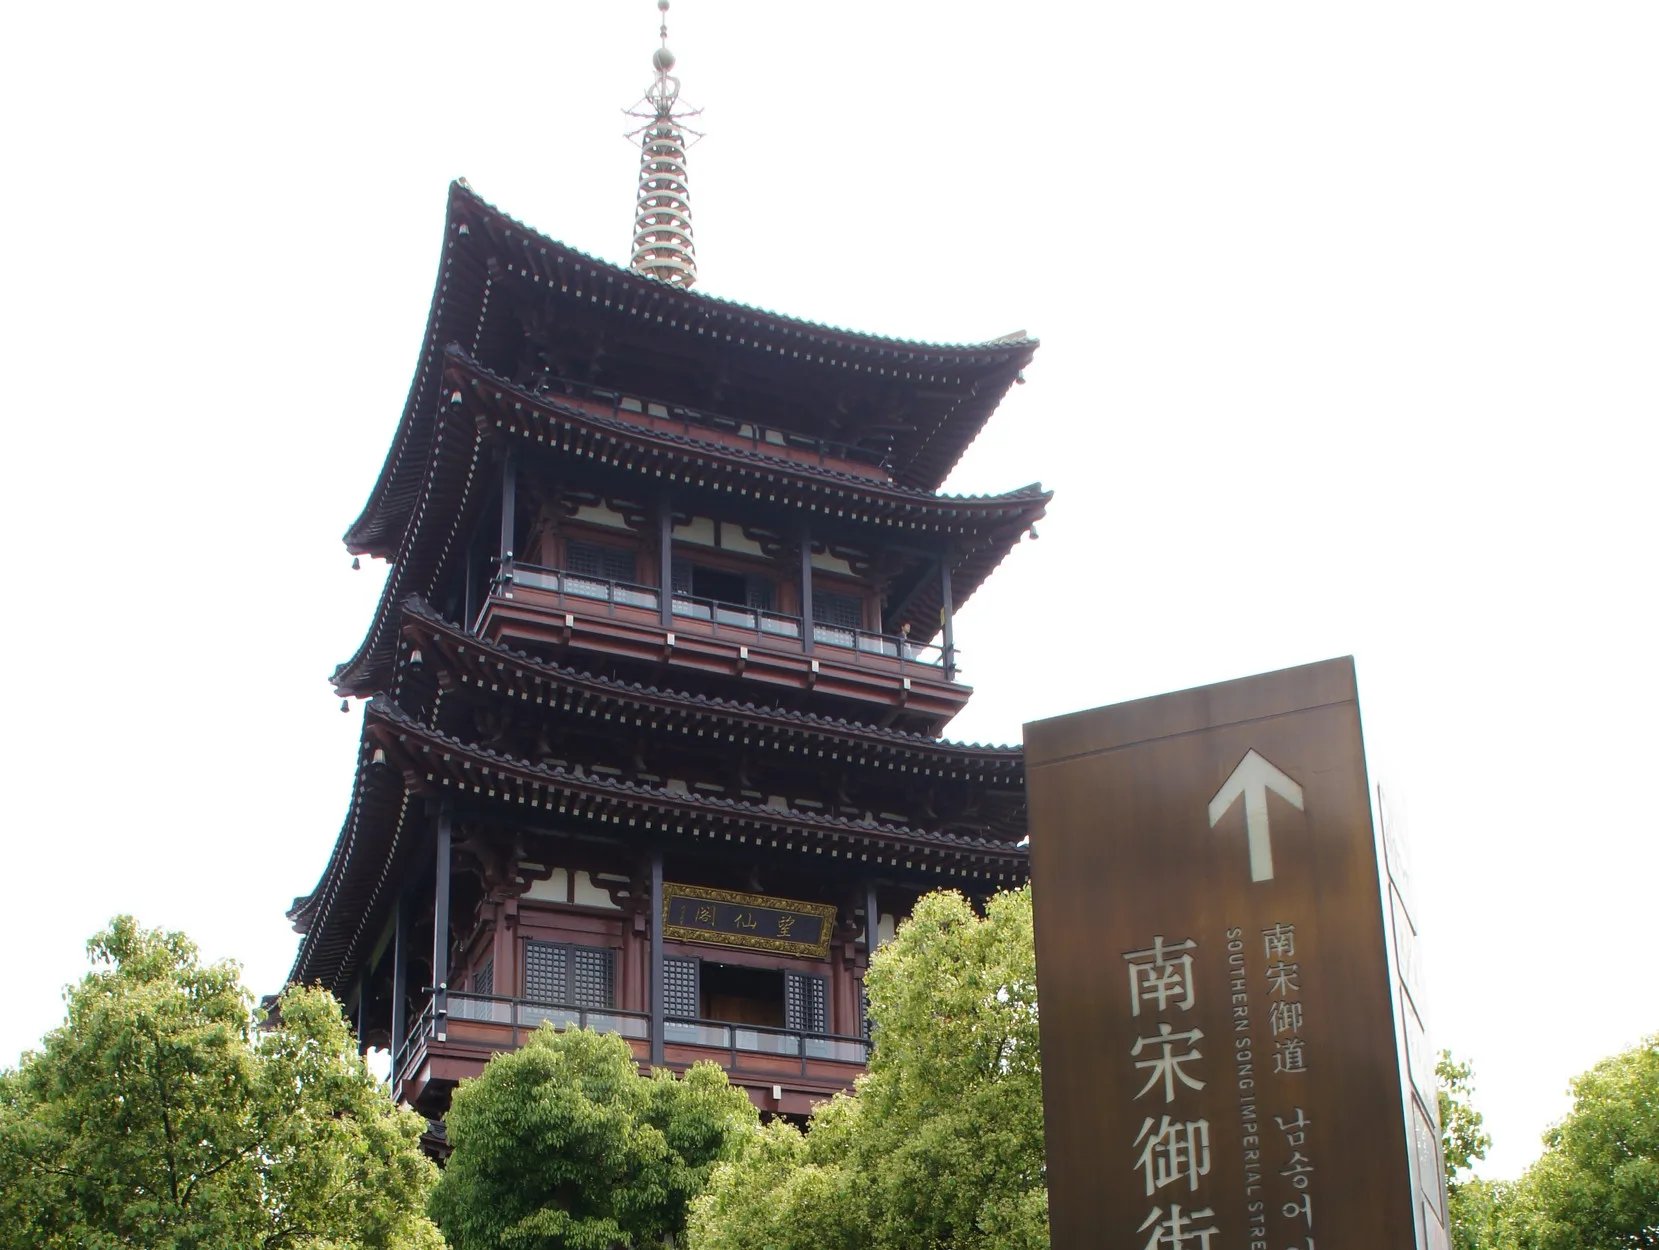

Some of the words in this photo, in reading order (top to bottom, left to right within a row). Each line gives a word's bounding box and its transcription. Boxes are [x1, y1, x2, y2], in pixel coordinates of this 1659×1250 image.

[1226, 927, 1249, 1032] SOUTHERN
[1261, 922, 1309, 1075] 南宋御道
[1234, 1037, 1254, 1089] SONG
[1240, 1093, 1262, 1196] IMPERIAL
